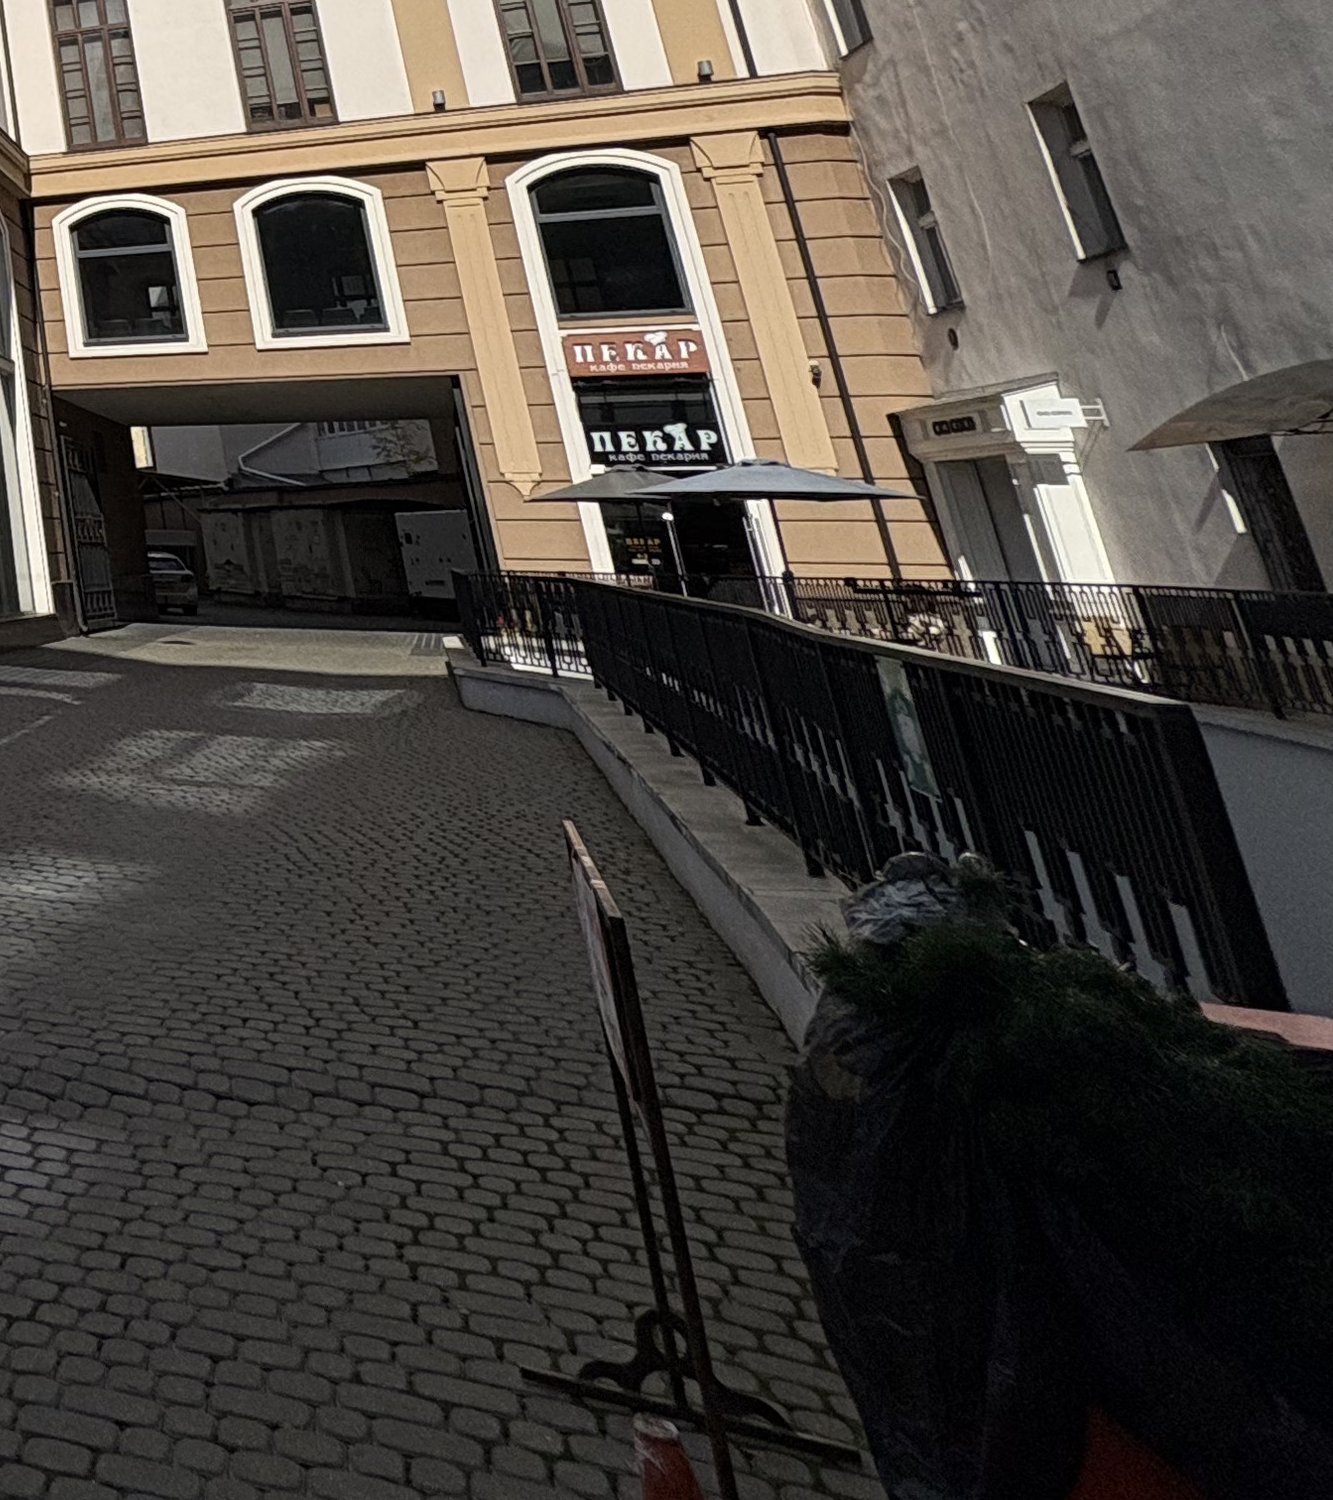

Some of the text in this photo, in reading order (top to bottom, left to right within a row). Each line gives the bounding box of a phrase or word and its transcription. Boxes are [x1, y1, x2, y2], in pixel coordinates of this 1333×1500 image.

[572, 338, 699, 363] ПЕКАР
[589, 362, 627, 373] кафе
[589, 429, 719, 452] ПЕКАР
[608, 453, 646, 463] кафе
